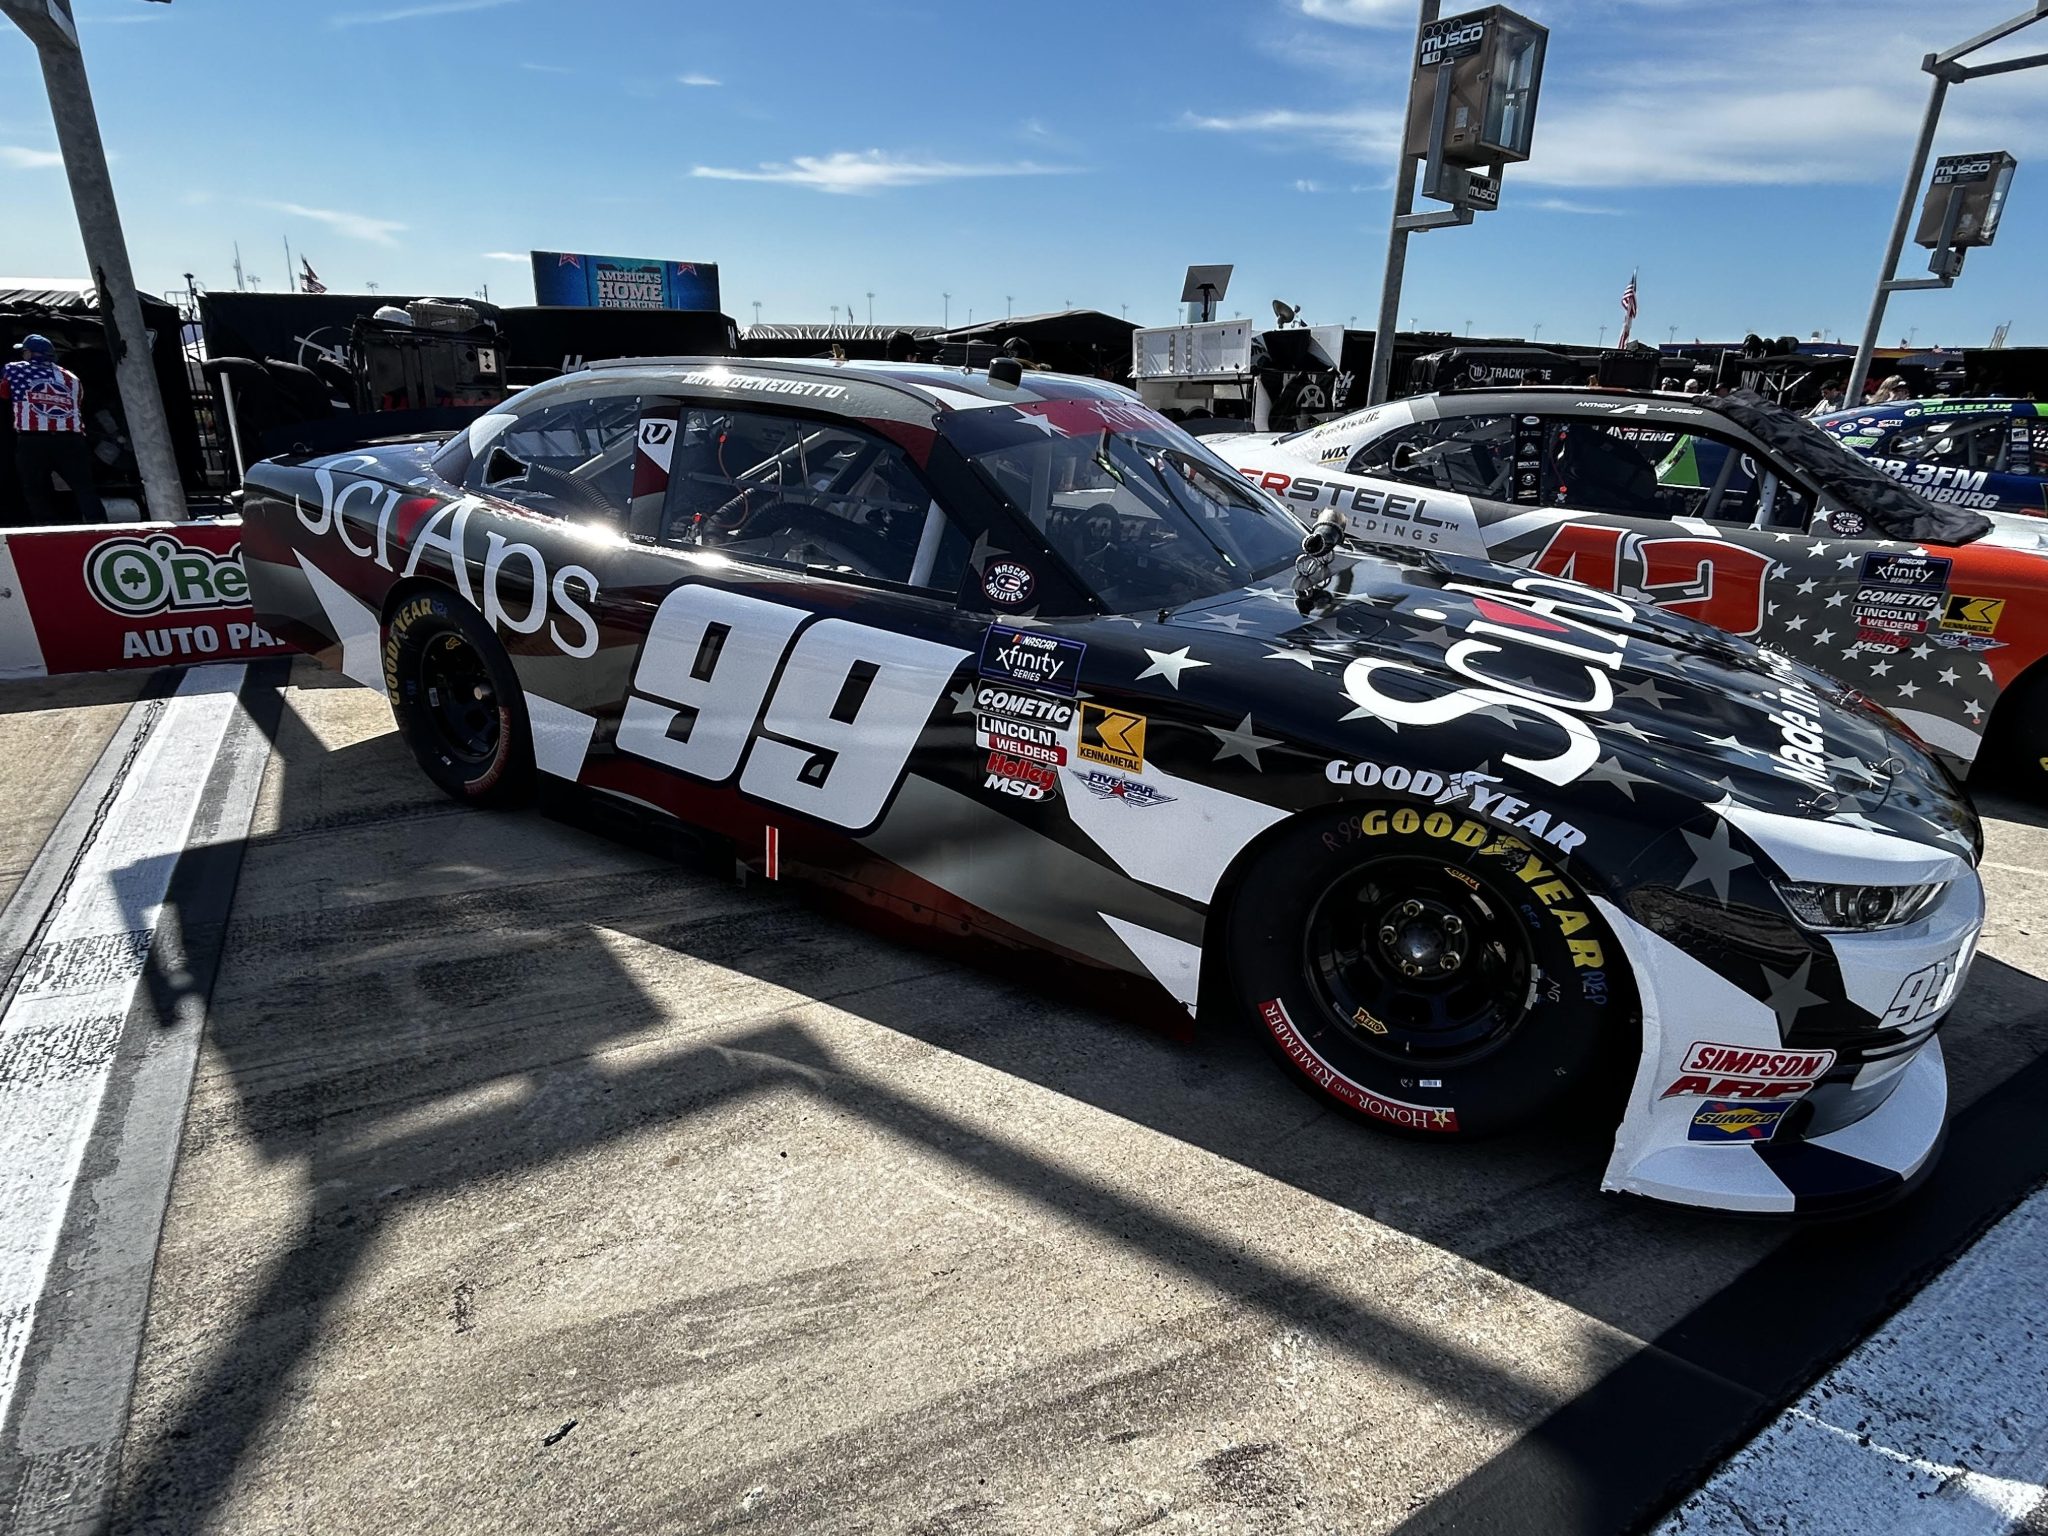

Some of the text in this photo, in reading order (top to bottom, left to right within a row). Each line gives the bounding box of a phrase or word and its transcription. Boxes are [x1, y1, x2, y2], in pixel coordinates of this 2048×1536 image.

[597, 270, 662, 284] AMERICA'S
[598, 281, 663, 300] HOME
[599, 299, 664, 309] FOR RACING
[1624, 432, 1675, 442] RACING
[1322, 445, 1352, 460] WIX
[1310, 508, 1440, 543] BLDINGS
[1832, 523, 1863, 533] SALUTES
[1896, 557, 1927, 566] NASCAR
[100, 545, 248, 606] O'Re
[994, 564, 1029, 584] NASCAR
[1875, 563, 1934, 583] xfinity
[1889, 577, 1914, 585] SERIES
[985, 582, 1023, 602] SALUTES
[1857, 589, 1938, 608] COMETIC
[1855, 606, 1917, 621] LINCOLN
[1866, 618, 1920, 631] WELDERS
[1942, 620, 1993, 633] KENNAMETAL
[123, 622, 287, 660] AUTO PA
[1022, 636, 1058, 651] NASCAR
[1850, 640, 1900, 654] MSD
[1856, 628, 1912, 648] Holley
[996, 645, 1064, 680] xfinity
[1012, 668, 1041, 682] SERIES
[615, 583, 975, 830] 99
[977, 688, 1071, 723] COMETIC
[982, 705, 1017, 717] GASKET
[1762, 687, 1822, 718] in
[981, 716, 1053, 746] LINCOLN
[996, 737, 1059, 763] WELDERS
[1080, 746, 1140, 771] KENNAMETAL
[1768, 710, 1837, 793] Made
[985, 751, 1056, 791] Holley
[983, 774, 1045, 801] MSD
[1088, 772, 1154, 797] FIVE STAR
[1325, 759, 1588, 855] GOODYEAR
[1361, 807, 1606, 969] GOODYEAR
[1357, 1014, 1382, 1032] AERO
[1264, 1003, 1428, 1128] HONOR AND REMEMBER
[1690, 1047, 1824, 1077] SIMPSON
[1659, 1075, 1813, 1100] ARP
[1699, 1112, 1775, 1124] SUNOCO
